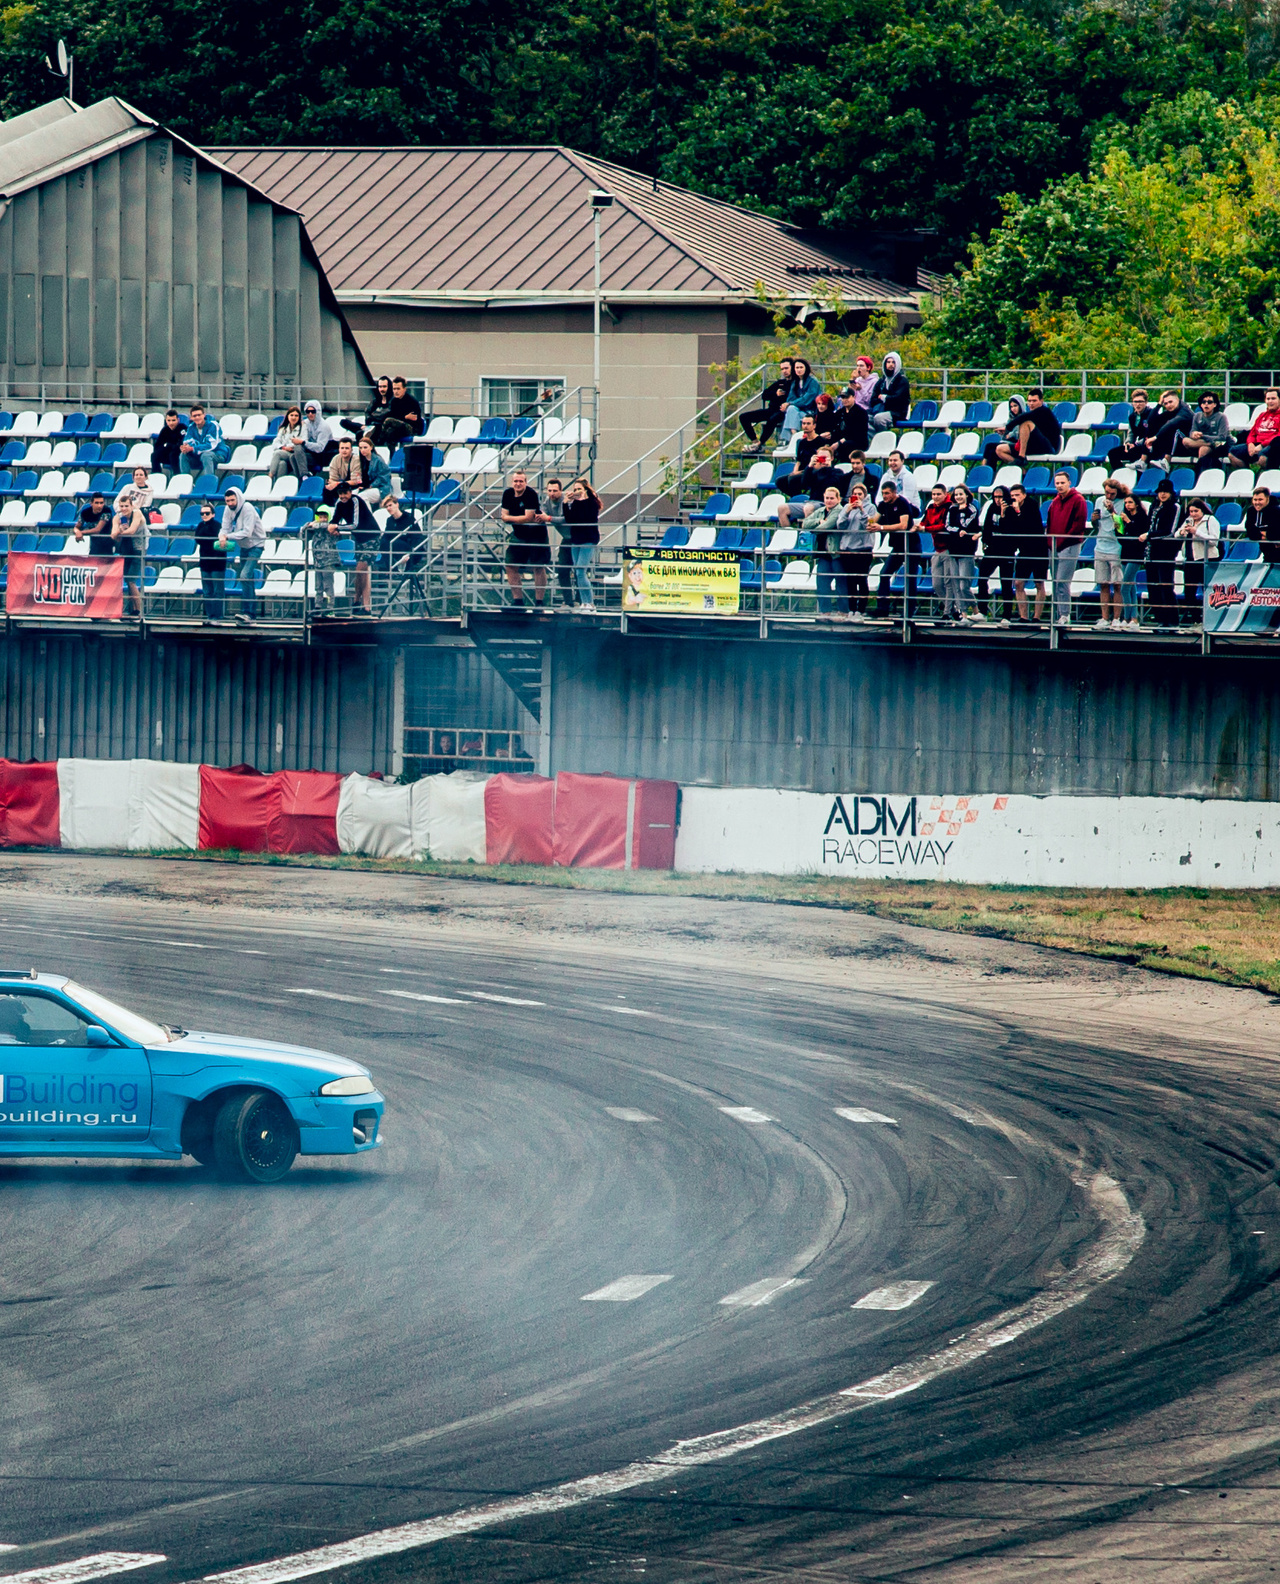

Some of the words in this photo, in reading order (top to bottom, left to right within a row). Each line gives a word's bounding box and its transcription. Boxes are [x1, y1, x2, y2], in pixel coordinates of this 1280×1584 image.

[660, 550, 736, 561] АВТОЗАПЧАСТИ
[62, 567, 97, 587] DRIFT
[648, 564, 661, 575] ВСЕ
[662, 565, 677, 577] ДЛЯ
[677, 566, 717, 578] ИНОМАРОК
[723, 567, 737, 578] ВАЗ
[63, 586, 86, 605] FUN
[823, 796, 917, 836] ADM
[822, 839, 954, 865] RACEWAY
